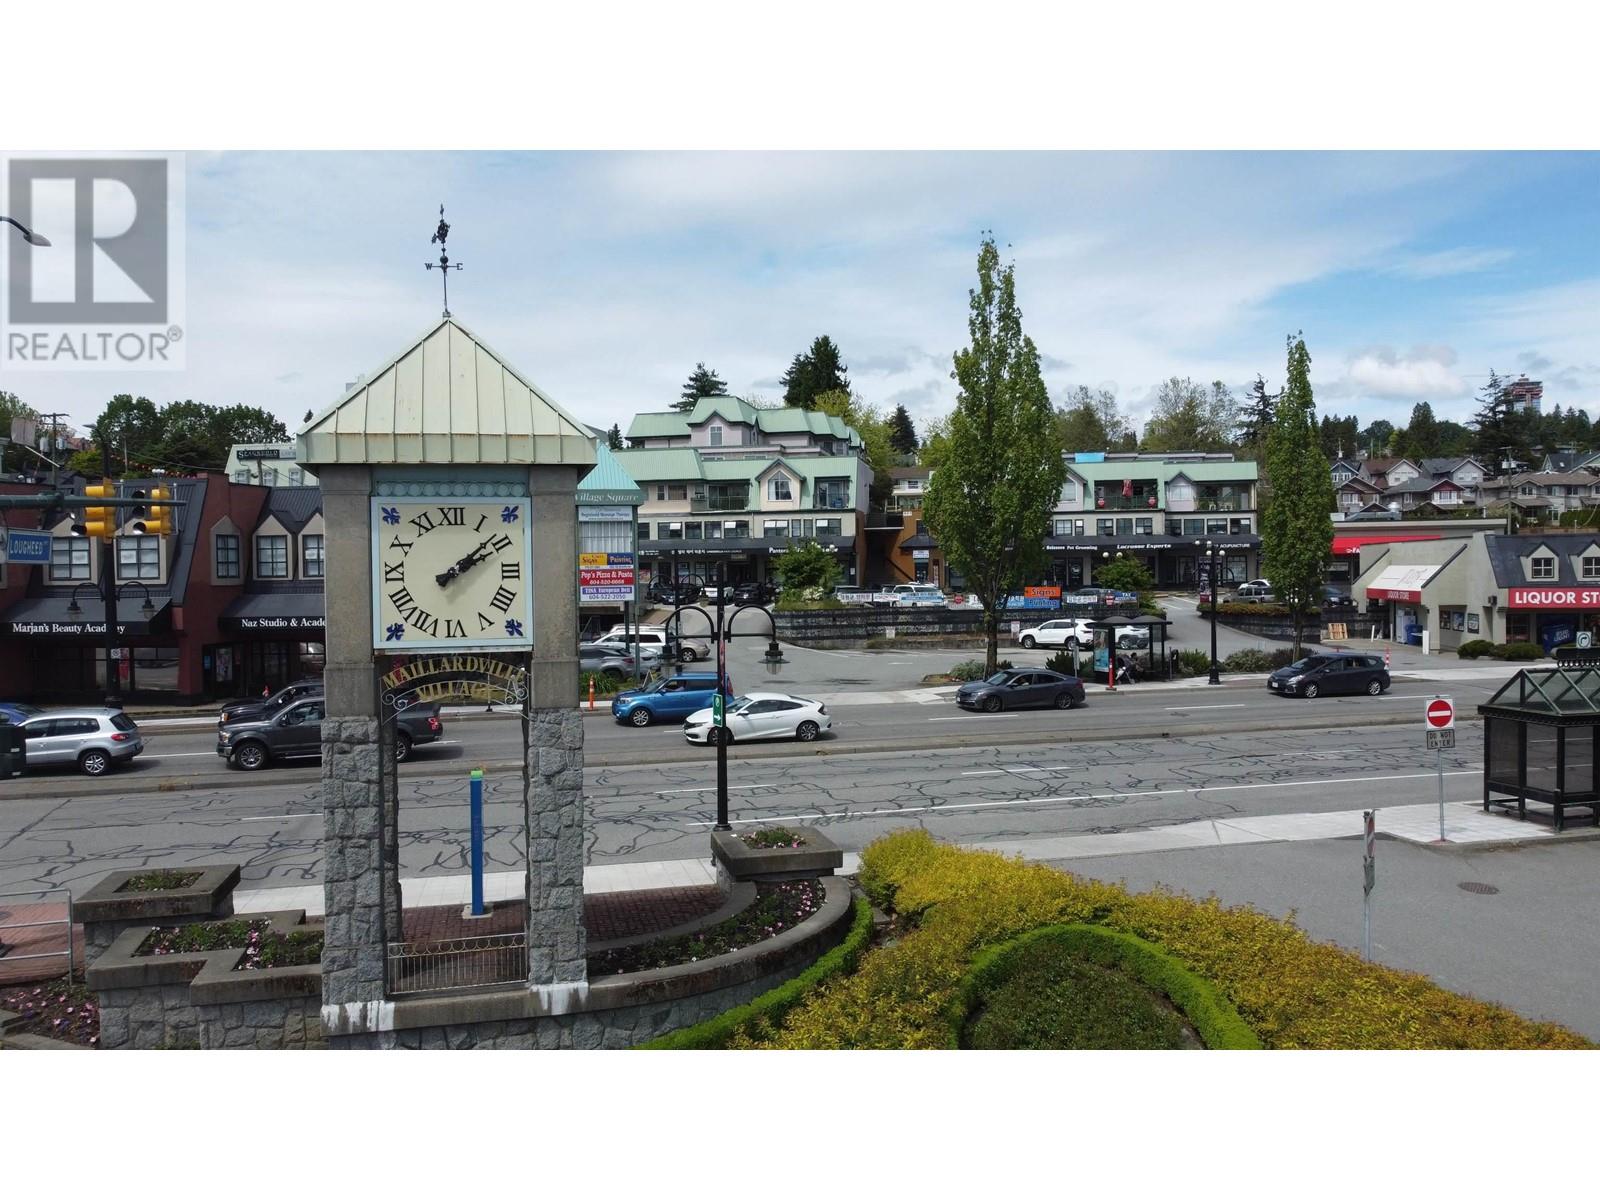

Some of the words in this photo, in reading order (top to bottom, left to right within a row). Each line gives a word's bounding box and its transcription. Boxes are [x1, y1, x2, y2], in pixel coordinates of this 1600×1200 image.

[607, 493, 639, 502] Square
[408, 511, 437, 537] XI
[437, 507, 466, 526] XII
[473, 513, 488, 533] I
[10, 540, 43, 555] LOUGHEED
[389, 534, 414, 558] X
[491, 534, 513, 554] II
[384, 561, 405, 584] IX
[501, 561, 520, 581] III
[489, 584, 517, 614] IIII
[1032, 588, 1056, 596] Signs
[1515, 592, 1576, 604] LIQUOR
[1582, 592, 1600, 604] ST
[388, 585, 419, 623] VIII
[12, 623, 49, 635] Marjan's
[52, 623, 82, 634] Beauty
[84, 623, 125, 634] Acady
[241, 619, 258, 627] Naz
[260, 618, 288, 627] Studio
[290, 618, 298, 627] &
[411, 608, 439, 638] VII
[444, 619, 468, 638] VI
[478, 611, 495, 631] V
[382, 656, 526, 690] MAILLARDVILLE
